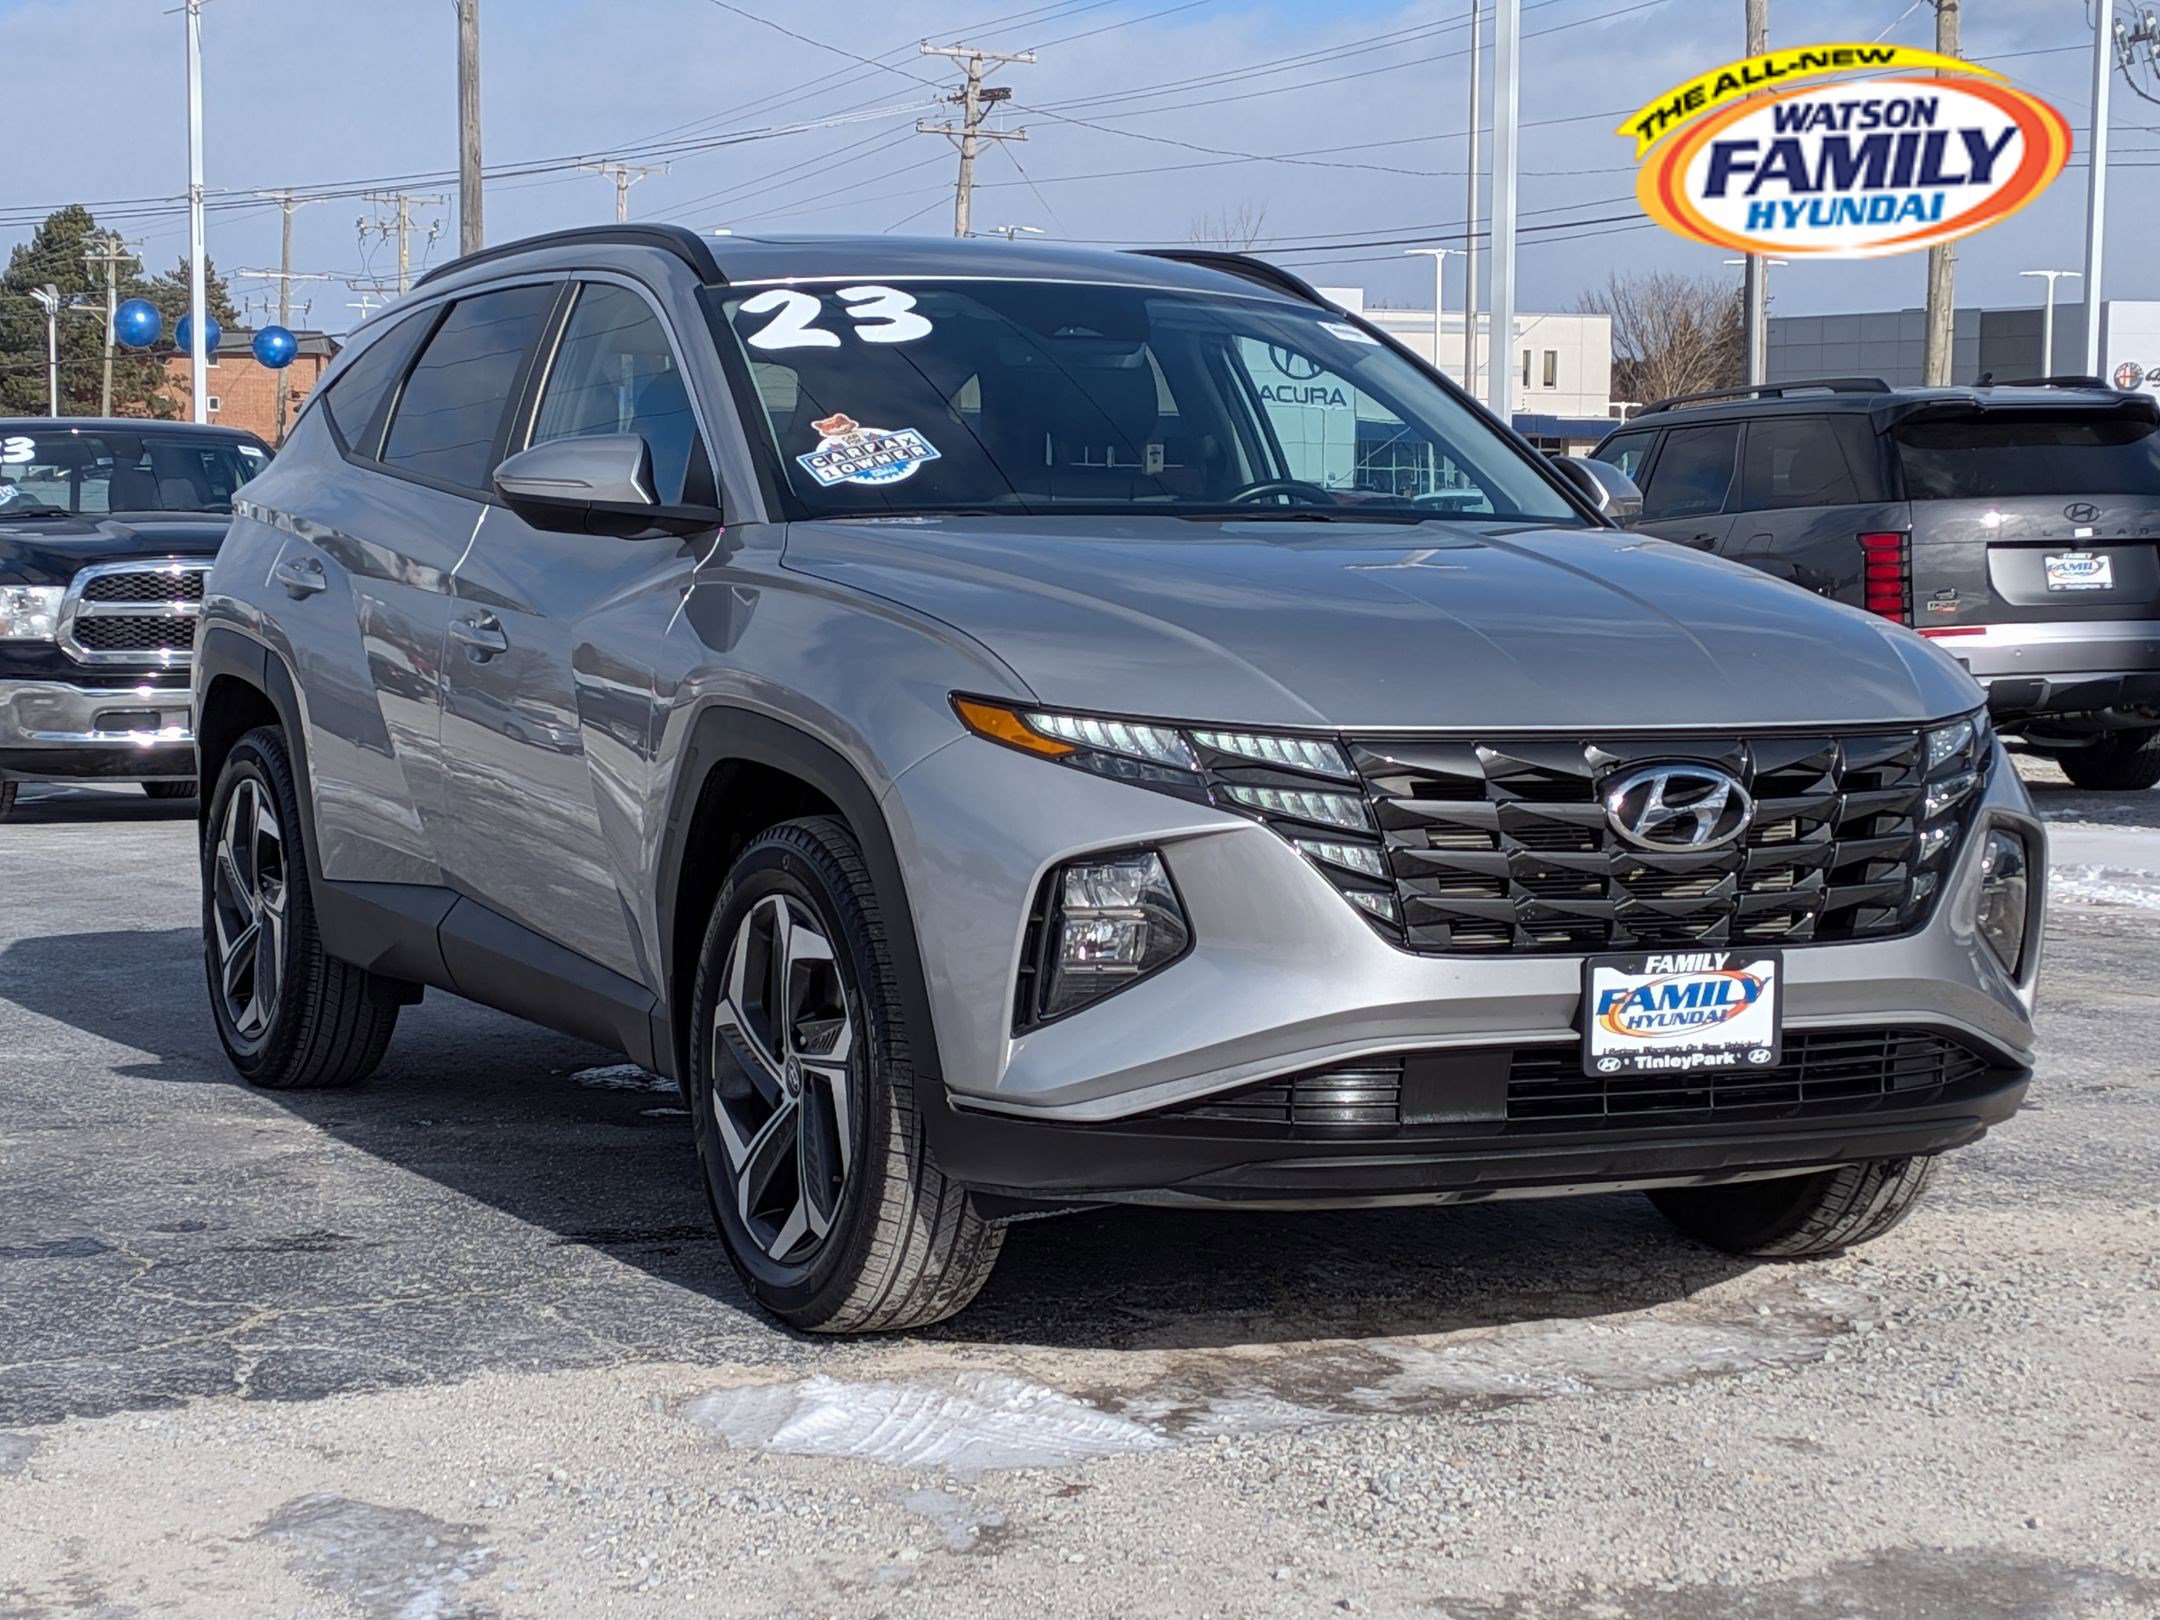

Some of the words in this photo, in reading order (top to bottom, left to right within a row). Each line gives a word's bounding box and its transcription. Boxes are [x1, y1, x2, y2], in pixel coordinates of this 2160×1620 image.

[739, 285, 934, 350] 23
[1260, 384, 1347, 407] ACURA
[0, 437, 35, 463] 3
[811, 437, 916, 467] CARFAX
[841, 446, 926, 473] OWNER
[1644, 952, 1731, 974] FAMILY
[1596, 976, 1772, 1015] FAMILY
[1627, 1009, 1728, 1029] HYUNDAI
[1634, 1052, 1736, 1070] TinleyPark
